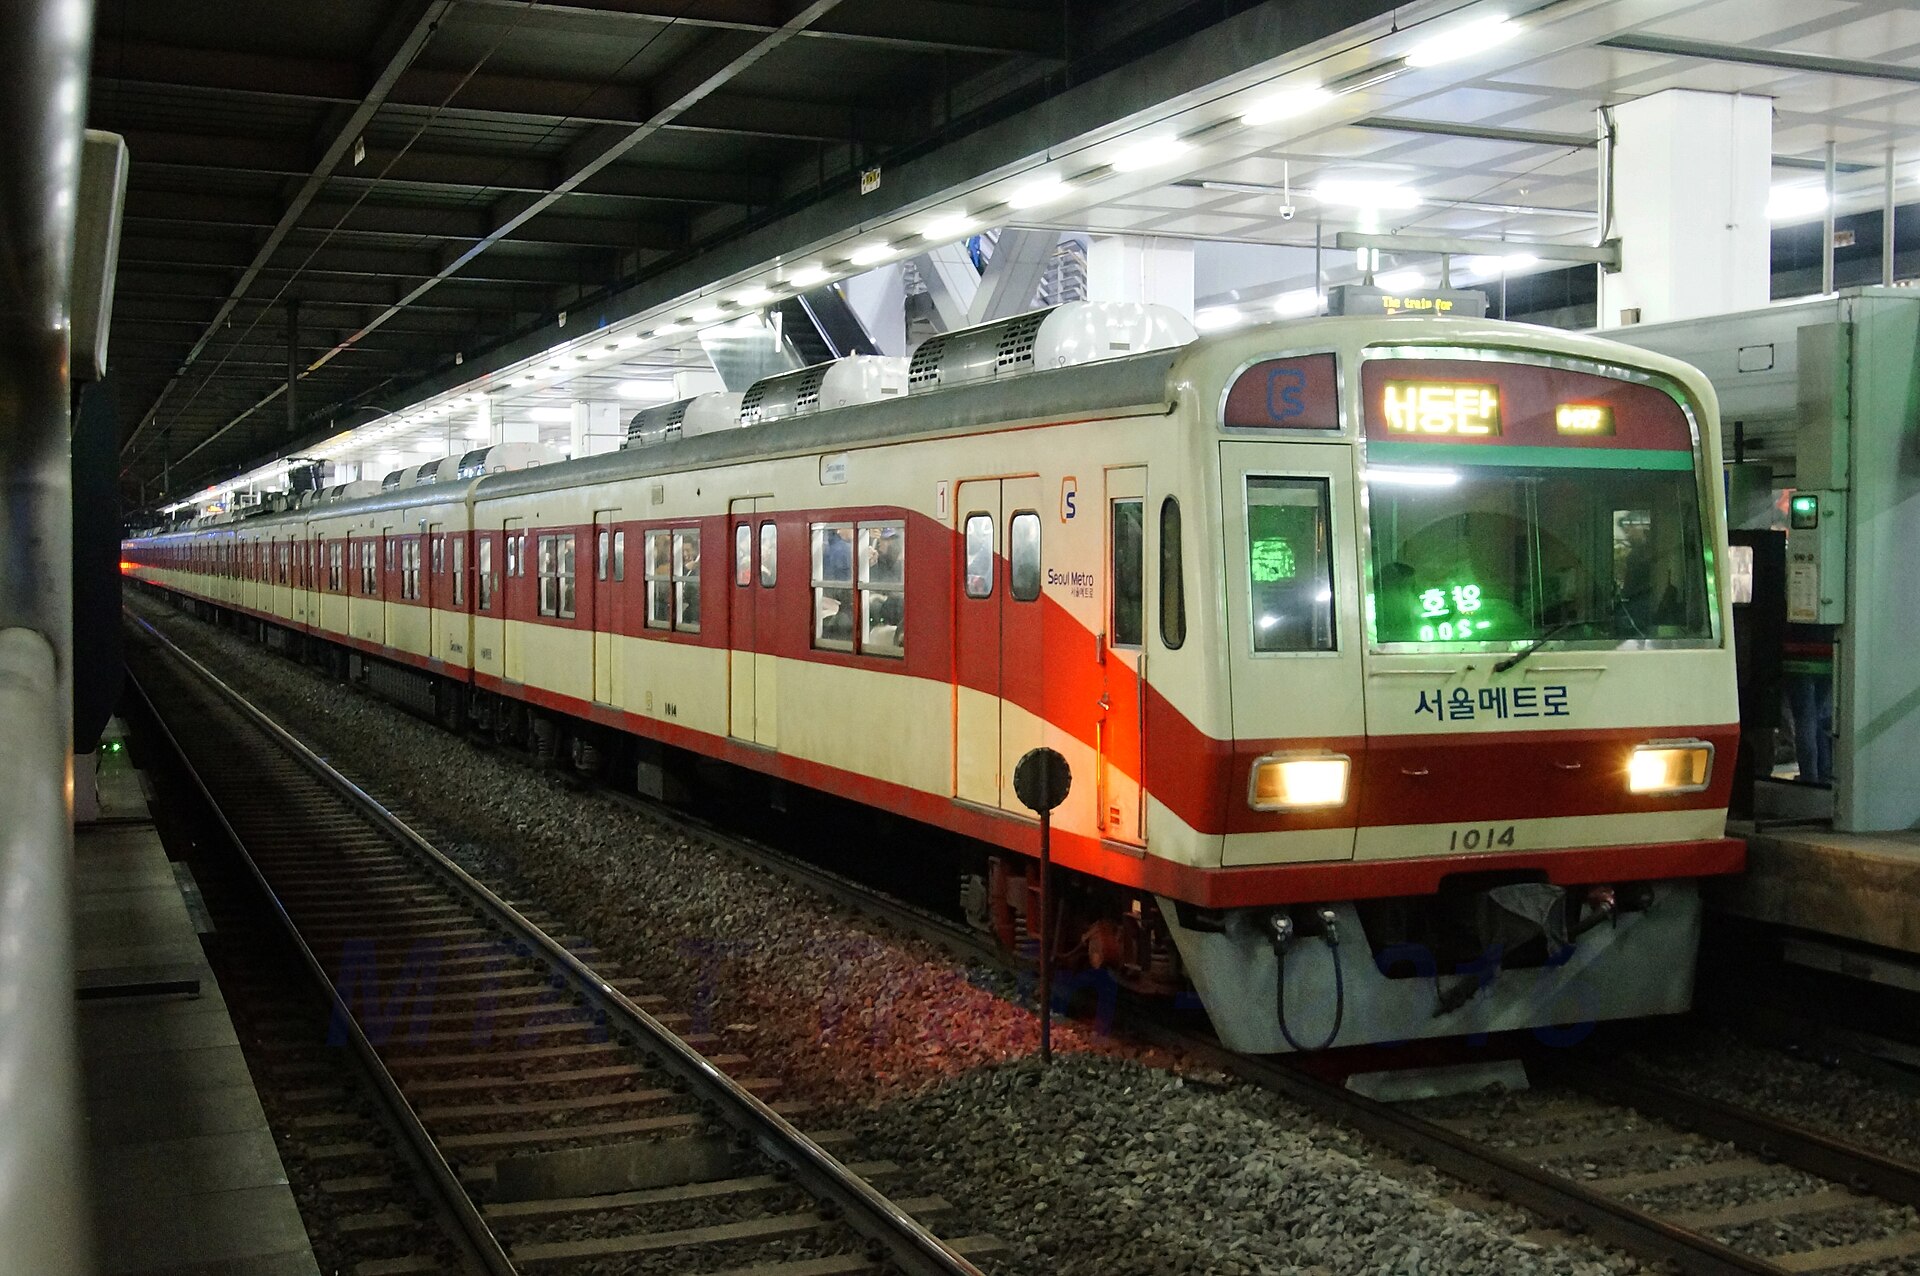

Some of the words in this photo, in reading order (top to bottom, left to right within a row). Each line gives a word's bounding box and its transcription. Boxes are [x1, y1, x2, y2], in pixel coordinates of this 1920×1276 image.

[1382, 295, 1401, 308] The
[1404, 297, 1433, 309] train
[1435, 298, 1453, 311] for
[1384, 386, 1498, 433] 서동탄
[939, 487, 946, 513] 1
[1047, 568, 1070, 585] Seoul
[1071, 570, 1094, 587] Metro
[1414, 685, 1570, 722] 서울메트로
[1450, 826, 1515, 851] 1014
